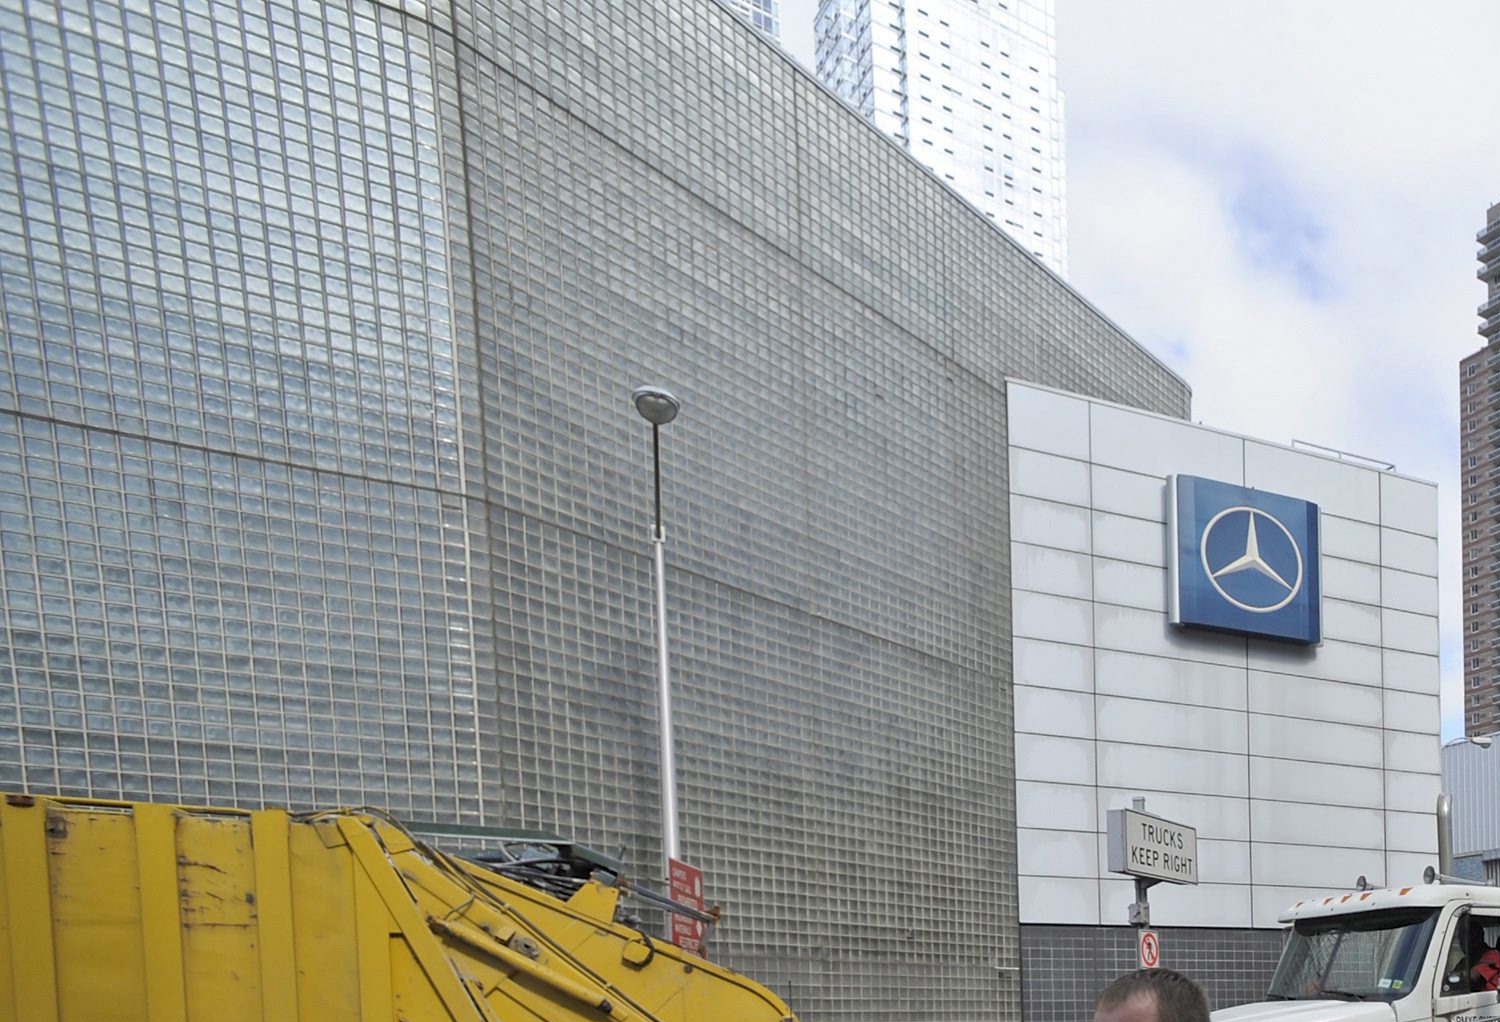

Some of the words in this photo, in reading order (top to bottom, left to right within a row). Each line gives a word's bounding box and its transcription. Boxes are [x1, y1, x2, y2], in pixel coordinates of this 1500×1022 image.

[1141, 823, 1184, 850] TRUCKS
[1131, 845, 1160, 867] KEEP
[1163, 852, 1193, 875] RIGHT
